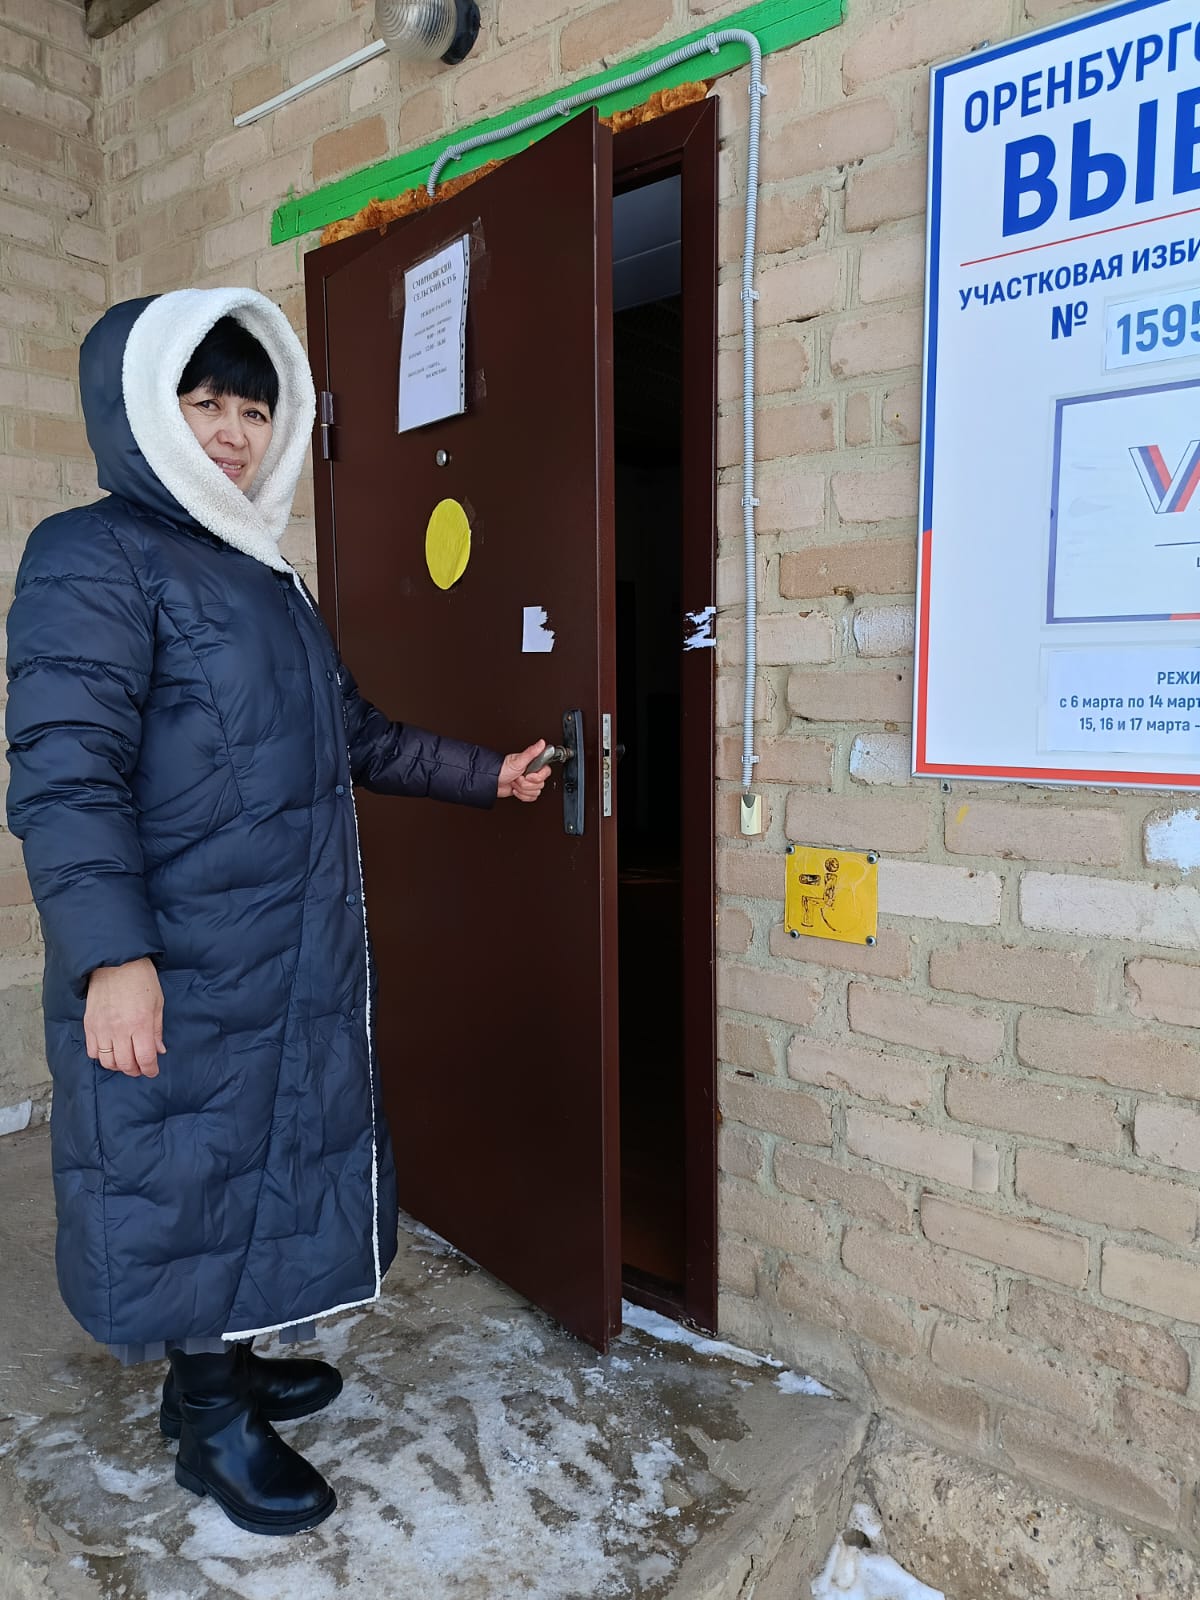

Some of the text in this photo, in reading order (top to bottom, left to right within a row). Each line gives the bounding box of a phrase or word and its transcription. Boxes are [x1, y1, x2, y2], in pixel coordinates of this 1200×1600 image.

[964, 21, 1200, 134] ОРЕНБУРГ
[959, 254, 1123, 311] УЧАСТКОВАЯ
[1051, 301, 1088, 340] №
[1059, 697, 1067, 708] с
[1070, 695, 1079, 708] 6
[1082, 697, 1123, 711] марта
[1128, 697, 1145, 708] по
[1148, 695, 1163, 708] 14
[1079, 717, 1096, 732] 15,
[1099, 717, 1114, 731] 16
[1117, 720, 1126, 731] и
[1130, 717, 1143, 731] 17
[1146, 720, 1190, 734] марта
